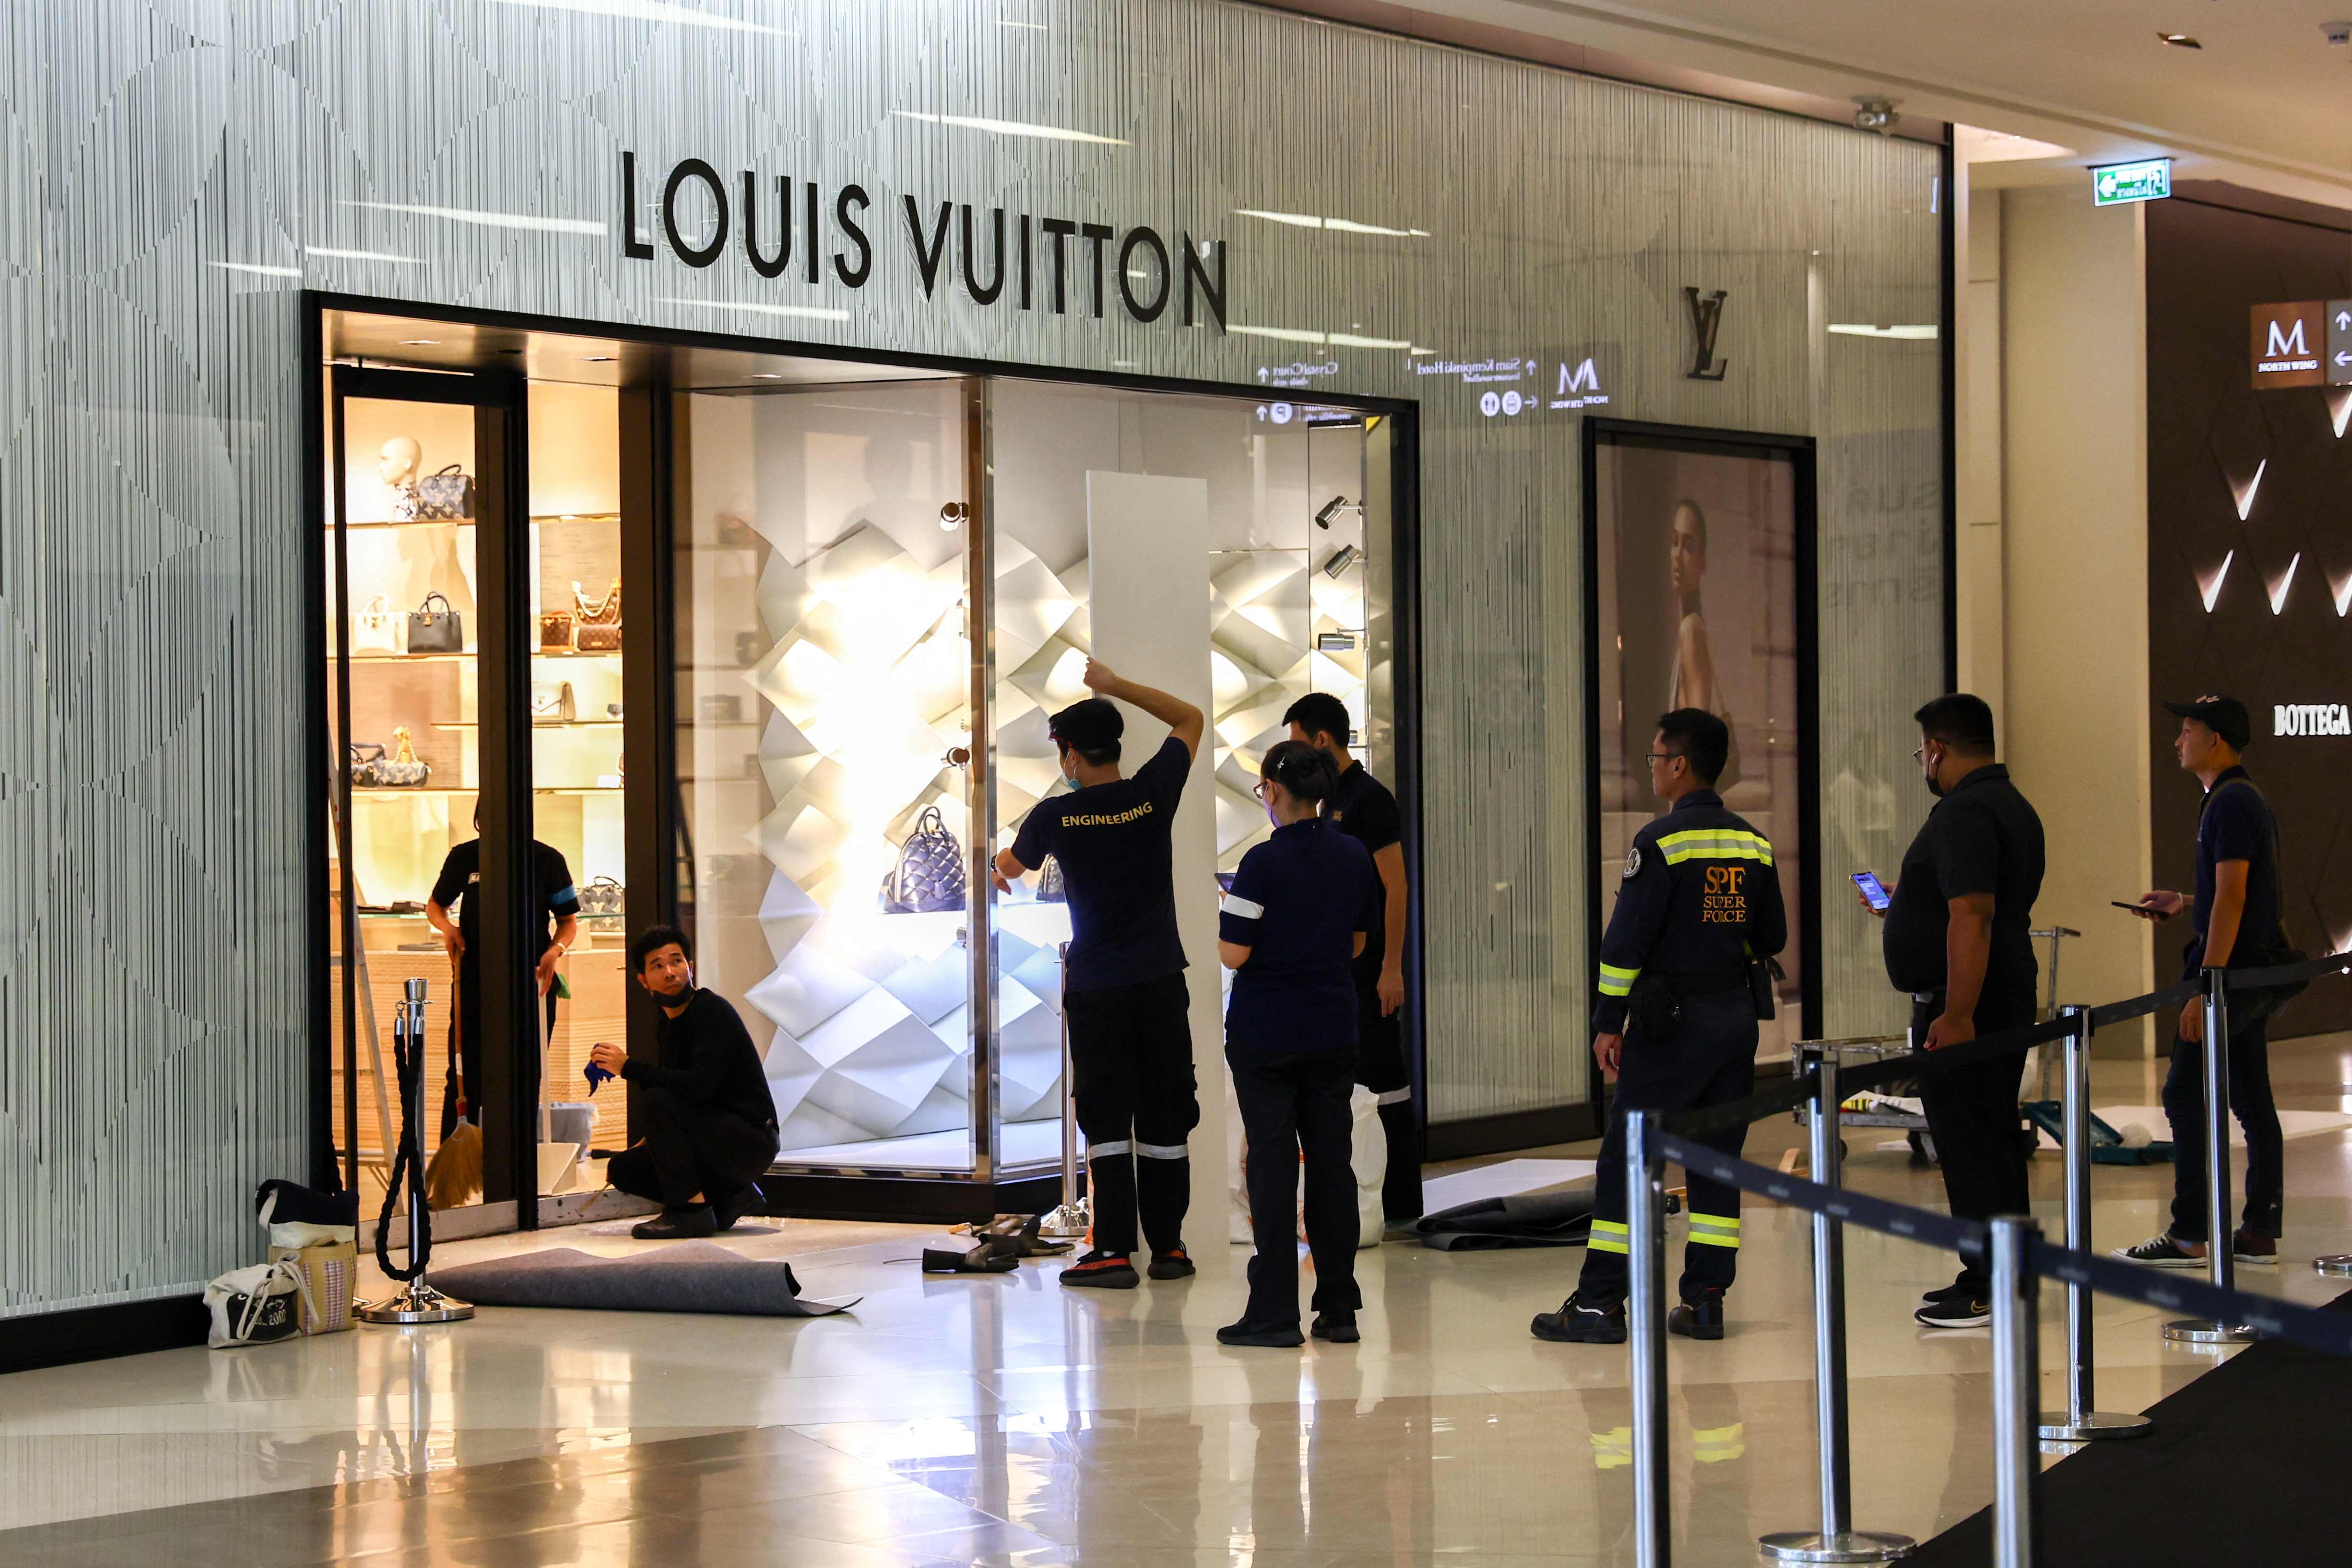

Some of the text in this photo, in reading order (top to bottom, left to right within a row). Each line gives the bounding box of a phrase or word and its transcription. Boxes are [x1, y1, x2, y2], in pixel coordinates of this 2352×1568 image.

[620, 150, 1227, 337] LOUIS VUITTON
[2265, 318, 2310, 357] M
[2257, 359, 2319, 373] NORTH WING
[2273, 703, 2352, 736] BOTTEGA
[1061, 801, 1153, 827] ENGINEERING
[1704, 866, 1746, 894] SPF
[1703, 896, 1747, 909] SUPER
